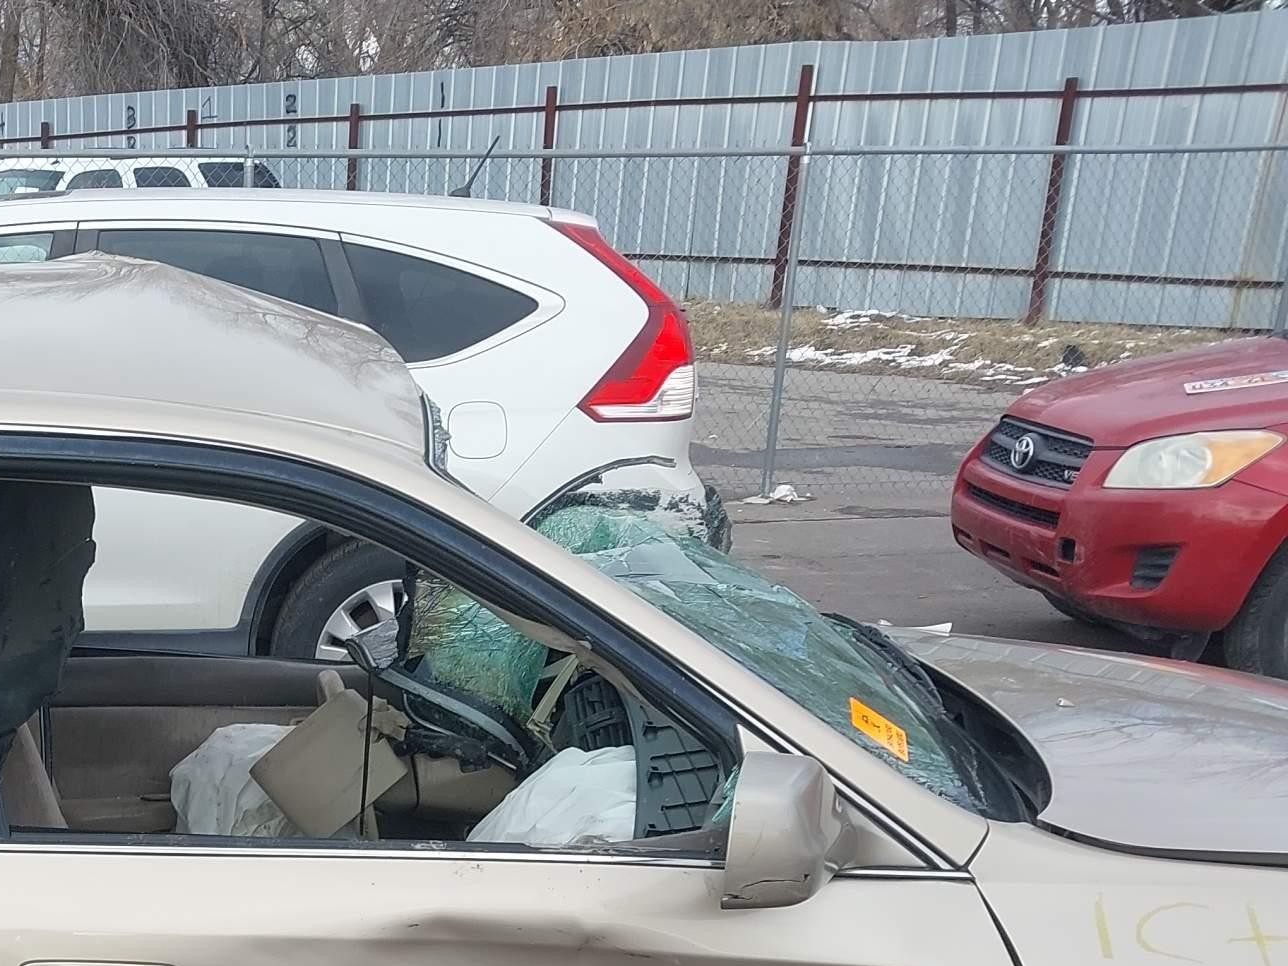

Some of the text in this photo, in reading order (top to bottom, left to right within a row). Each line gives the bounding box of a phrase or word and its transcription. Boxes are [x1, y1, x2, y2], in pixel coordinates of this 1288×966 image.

[201, 95, 219, 120] 1
[284, 93, 298, 115] 2
[285, 124, 299, 149] 2
